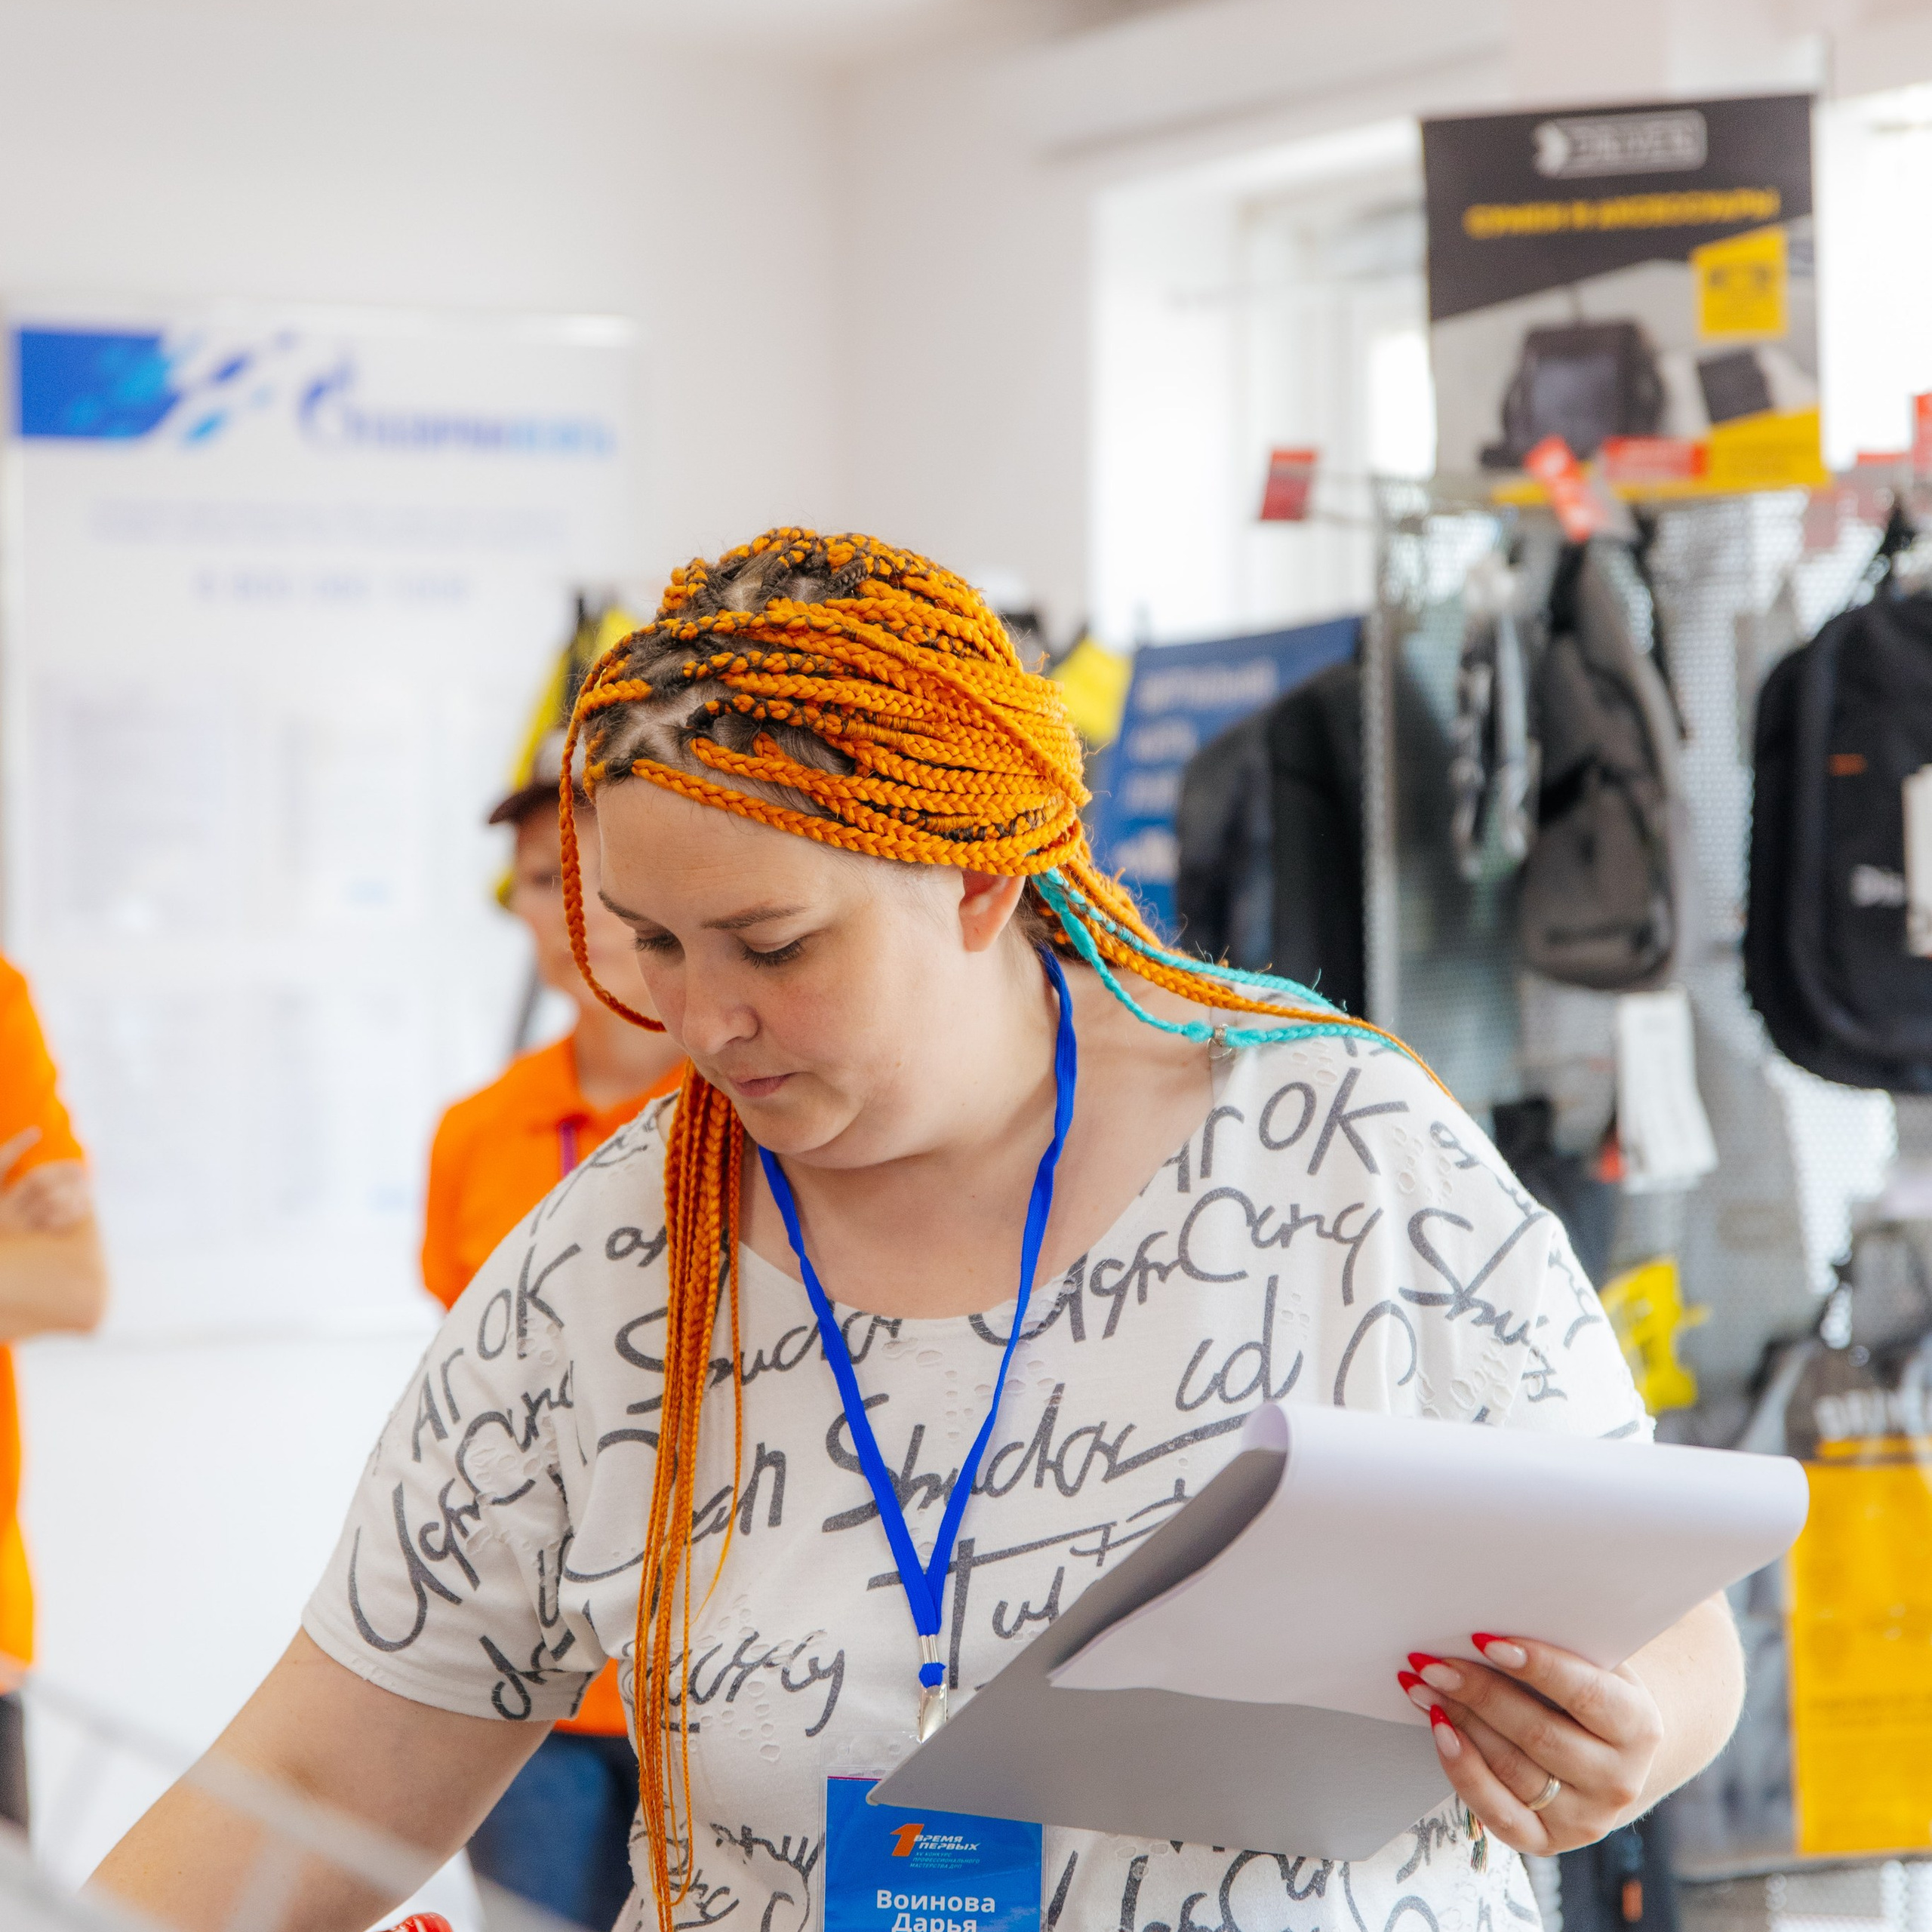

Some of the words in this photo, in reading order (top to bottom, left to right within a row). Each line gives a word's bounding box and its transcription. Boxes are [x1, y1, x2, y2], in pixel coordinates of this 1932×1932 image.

[913, 1834, 964, 1843] ВРЕМЯ
[918, 1841, 981, 1850] ПЕРВЫХ
[876, 1889, 996, 1913] Воинова
[891, 1912, 977, 1932] Дарья
